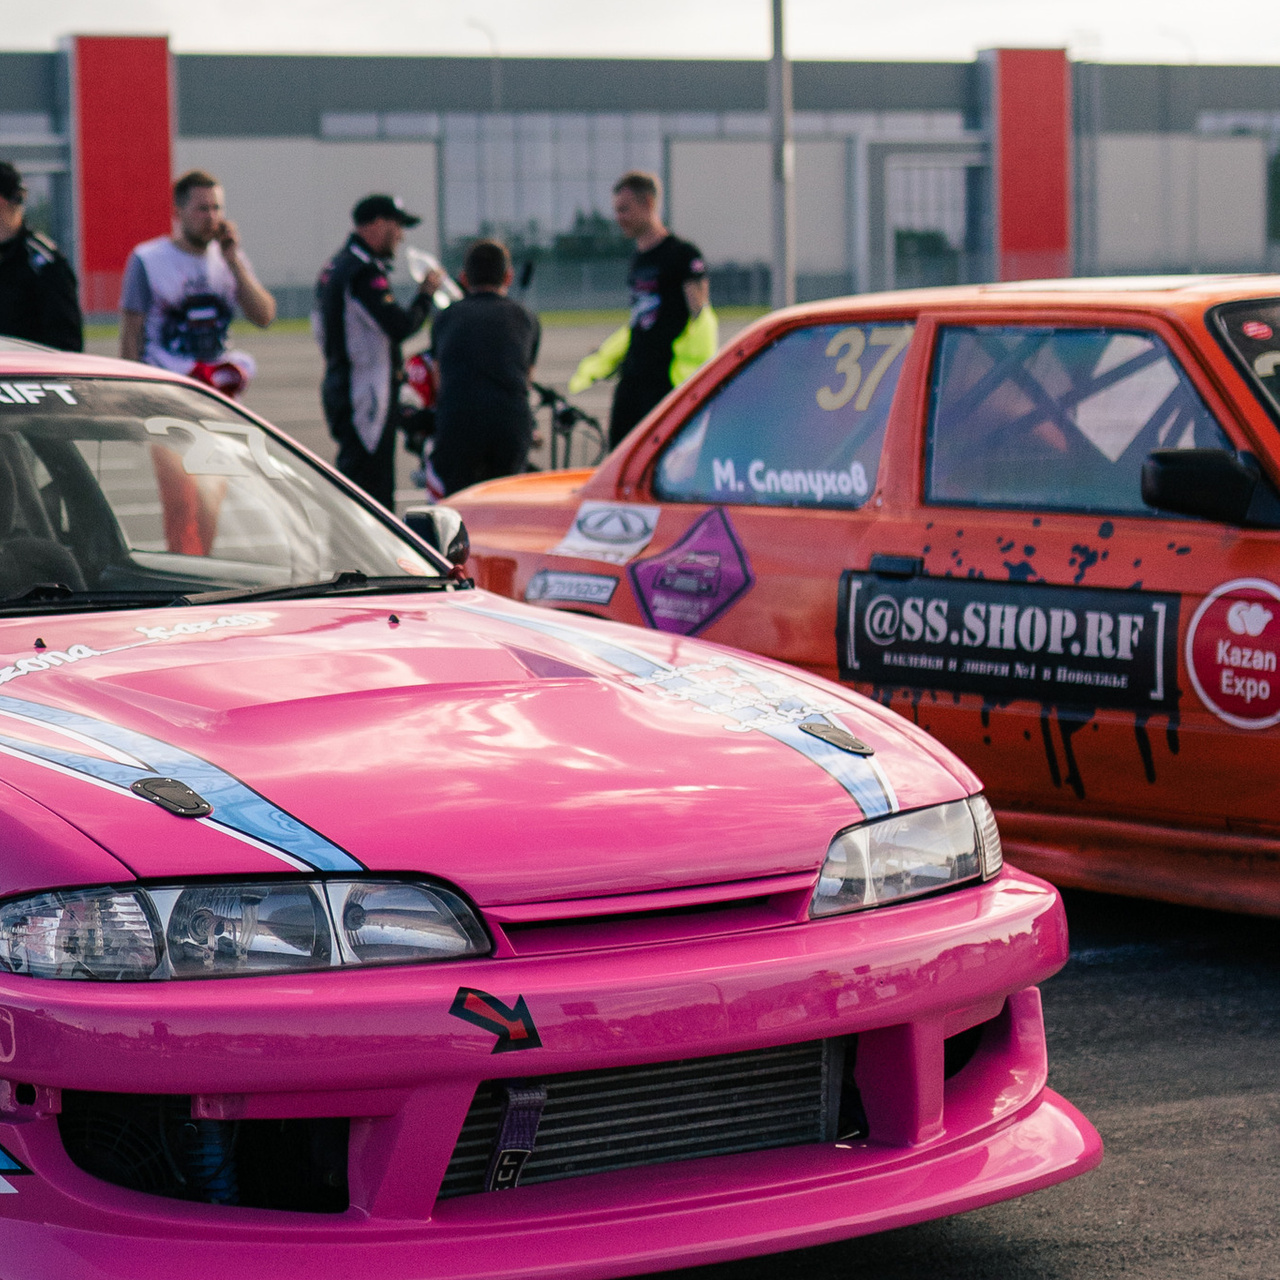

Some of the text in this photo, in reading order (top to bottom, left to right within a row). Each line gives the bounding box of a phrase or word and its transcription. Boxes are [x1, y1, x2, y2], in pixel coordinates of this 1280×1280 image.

[816, 327, 915, 411] 37
[144, 417, 284, 480] 27
[711, 458, 745, 492] М.
[864, 593, 1145, 661] @SS.SHOP.RF
[1217, 638, 1277, 673] Kazan
[1221, 668, 1270, 705] Expo
